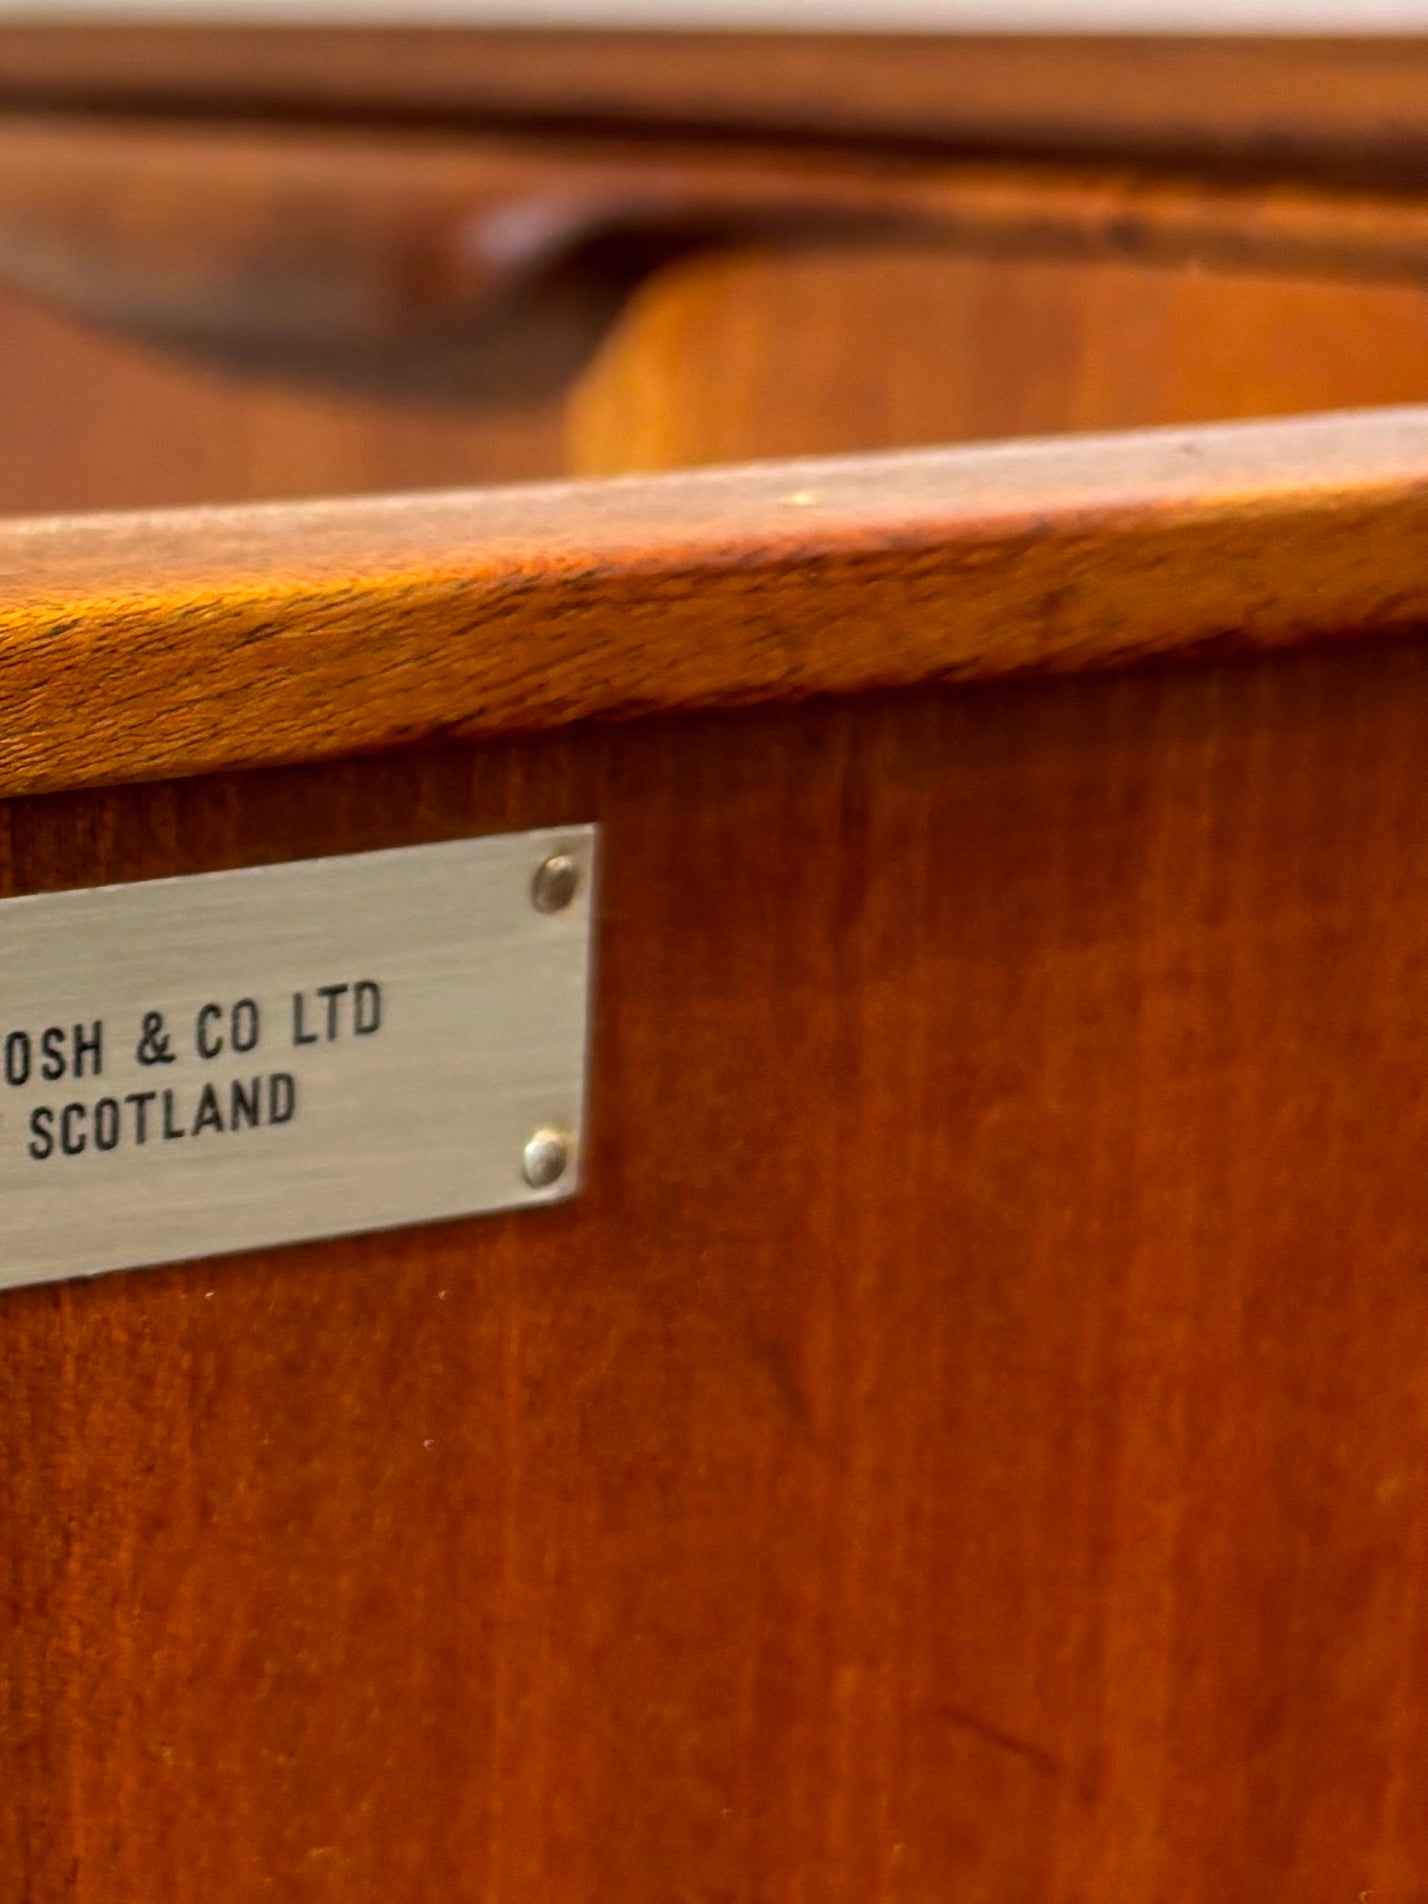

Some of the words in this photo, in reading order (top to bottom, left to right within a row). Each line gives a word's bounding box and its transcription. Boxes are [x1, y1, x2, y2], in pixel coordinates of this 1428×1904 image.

[136, 1009, 177, 1067] &
[196, 997, 260, 1060] CO
[292, 979, 383, 1046] LTD
[28, 1072, 296, 1161] SCOTLAND
